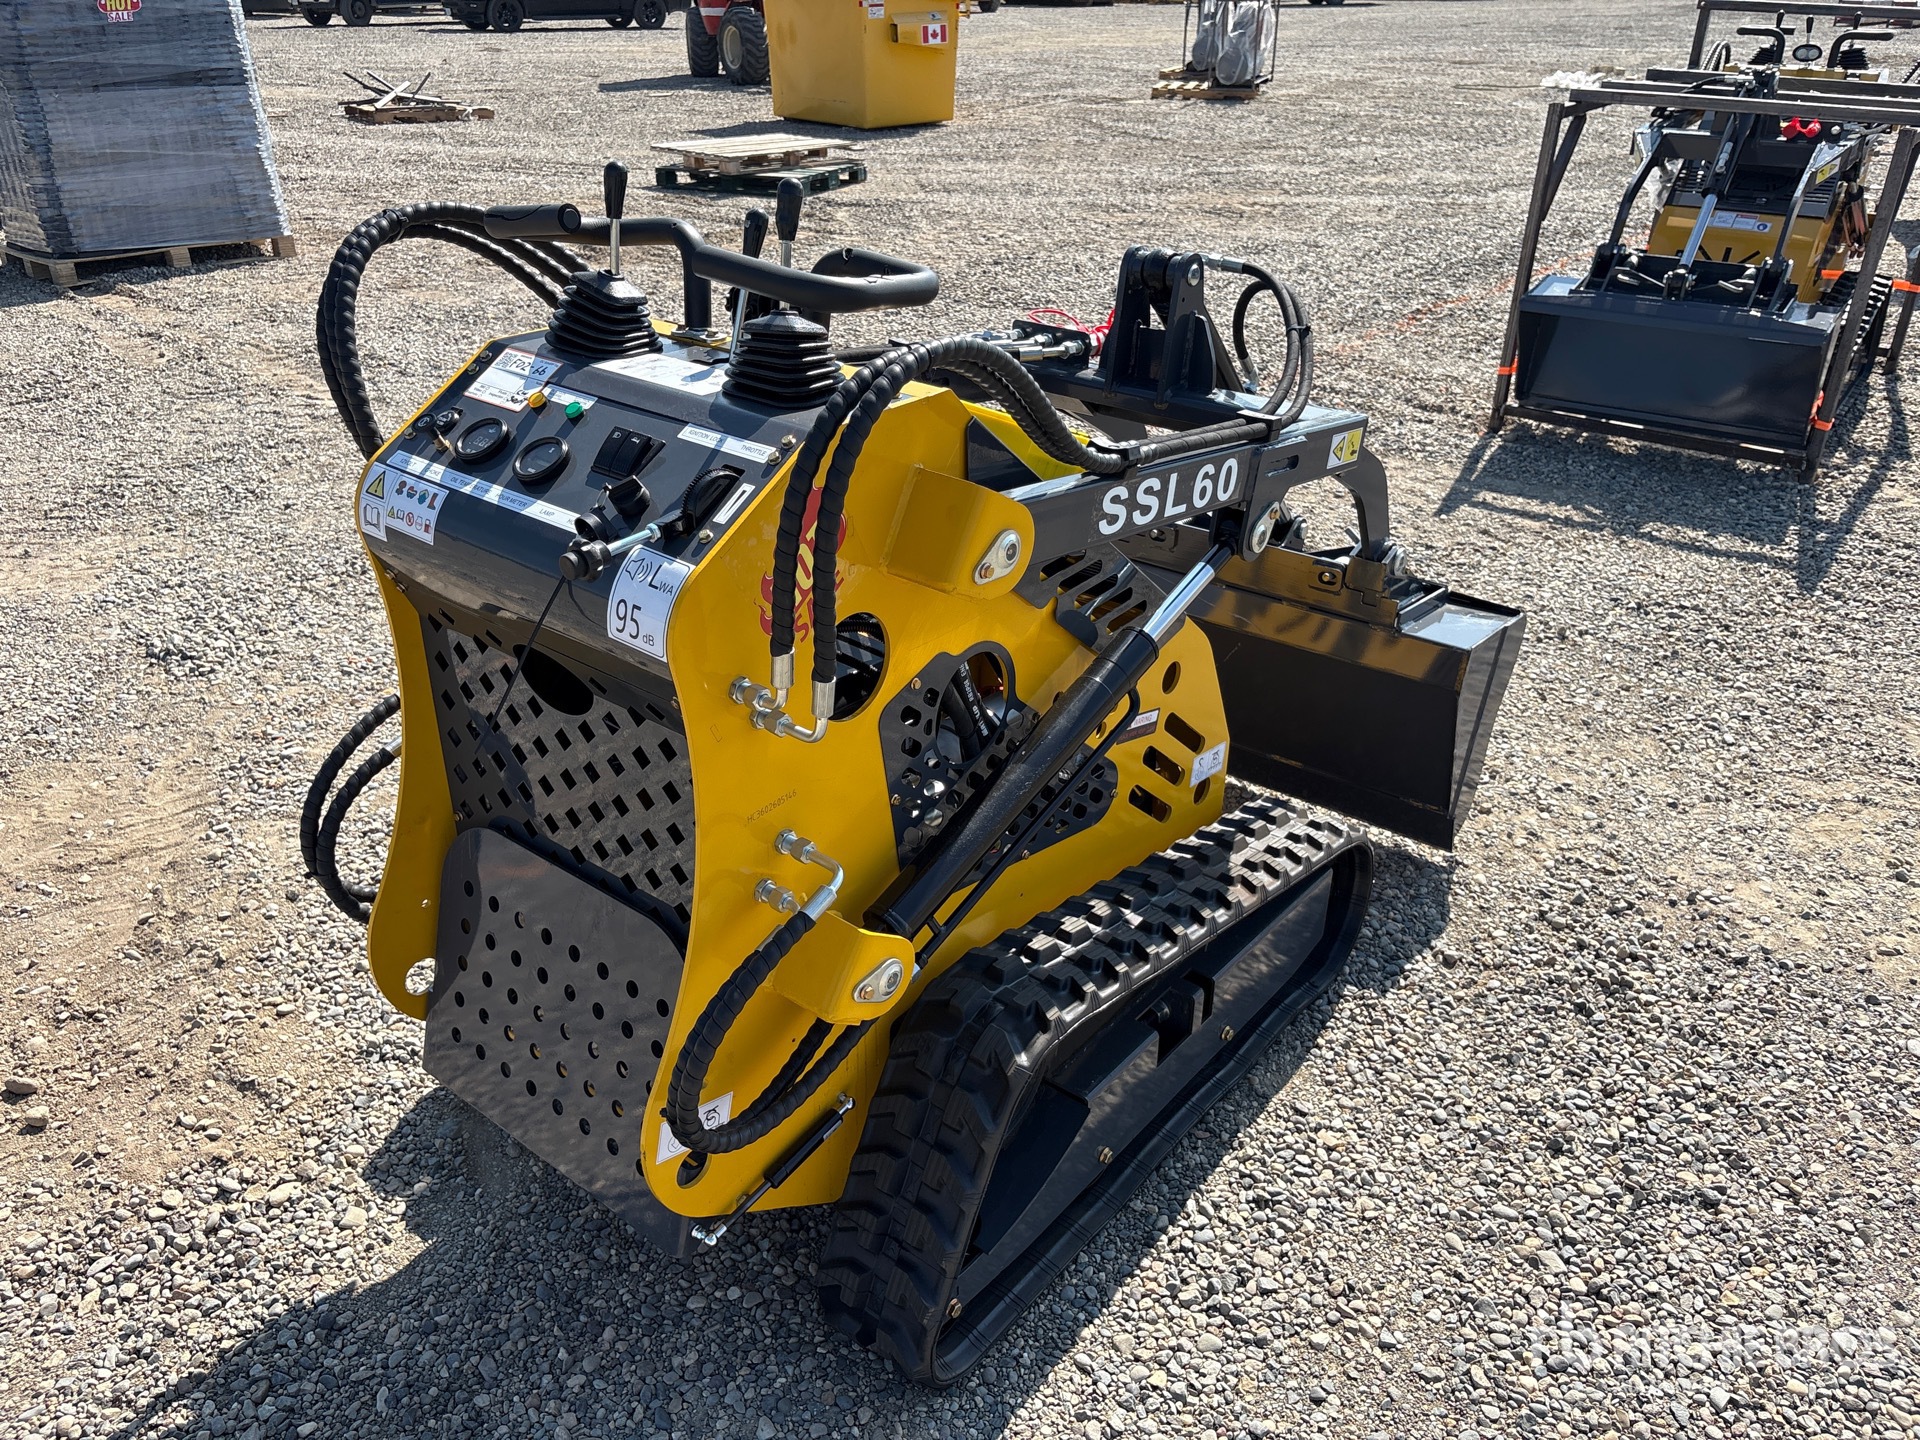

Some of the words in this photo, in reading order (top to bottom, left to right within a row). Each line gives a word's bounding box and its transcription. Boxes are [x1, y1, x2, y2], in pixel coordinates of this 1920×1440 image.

[106, 0, 132, 11] HOT
[108, 12, 133, 22] SALE
[688, 429, 709, 441] IGNITION
[709, 434, 724, 443] LOCK
[740, 444, 767, 457] THROTTLE
[425, 467, 442, 477] CHOKE
[450, 476, 459, 484] OIL
[457, 478, 492, 495] TEMPERATURE
[497, 492, 510, 503] HOUR
[509, 497, 528, 508] METER
[538, 508, 556, 517] LAMP
[1098, 457, 1239, 536] SSL60
[615, 598, 642, 640] 95
[642, 633, 655, 647] dB
